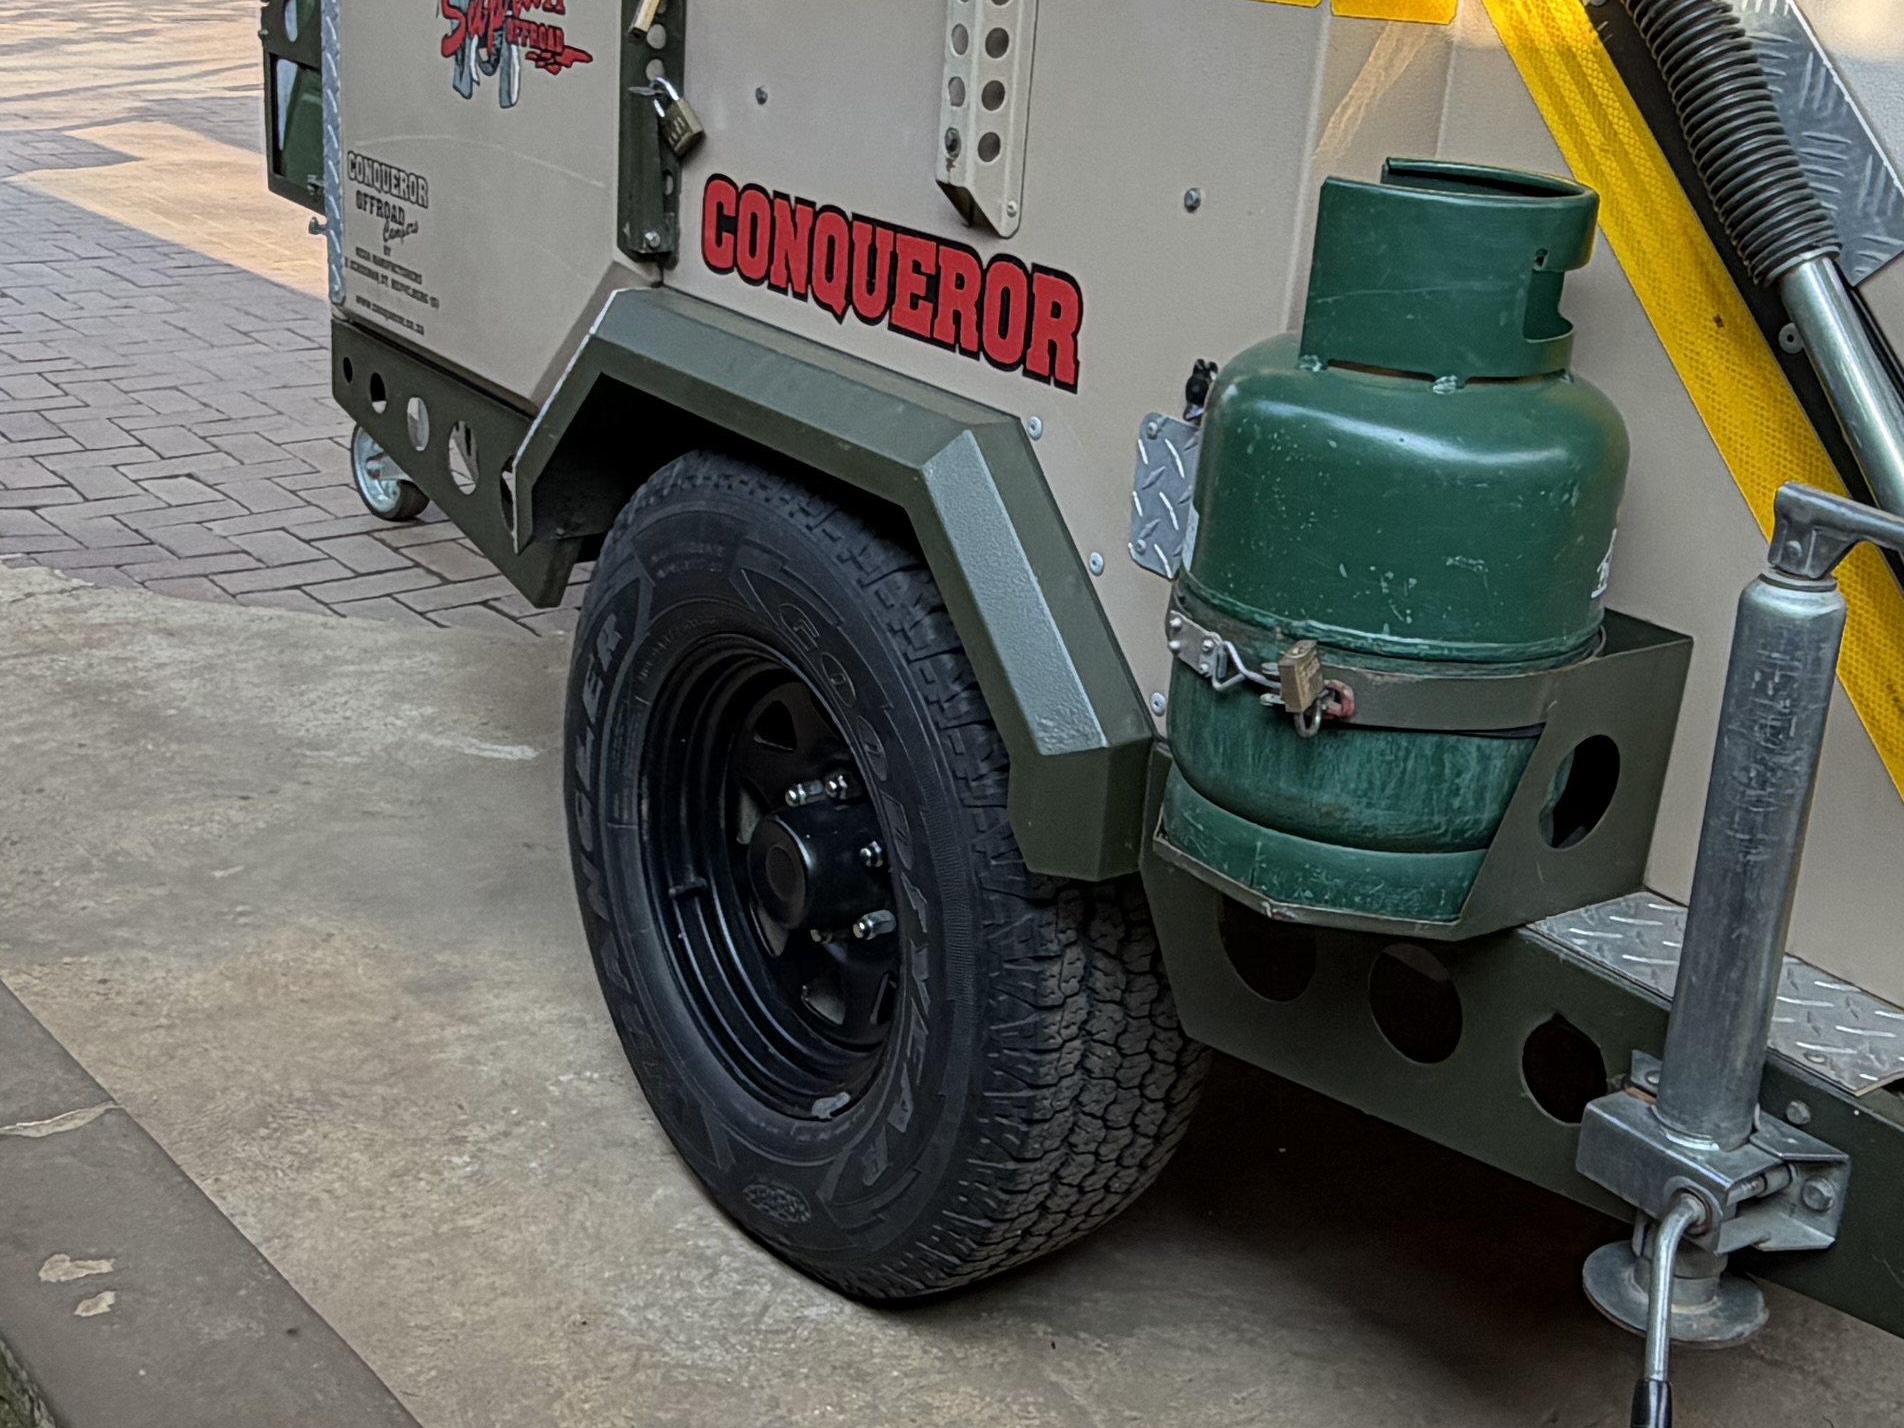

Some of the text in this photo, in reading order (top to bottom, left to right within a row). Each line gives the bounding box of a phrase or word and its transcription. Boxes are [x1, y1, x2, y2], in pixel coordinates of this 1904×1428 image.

[347, 150, 429, 209] CONQUEROR
[356, 190, 406, 226] OFFROAD
[701, 173, 1084, 394] CONQUEROR
